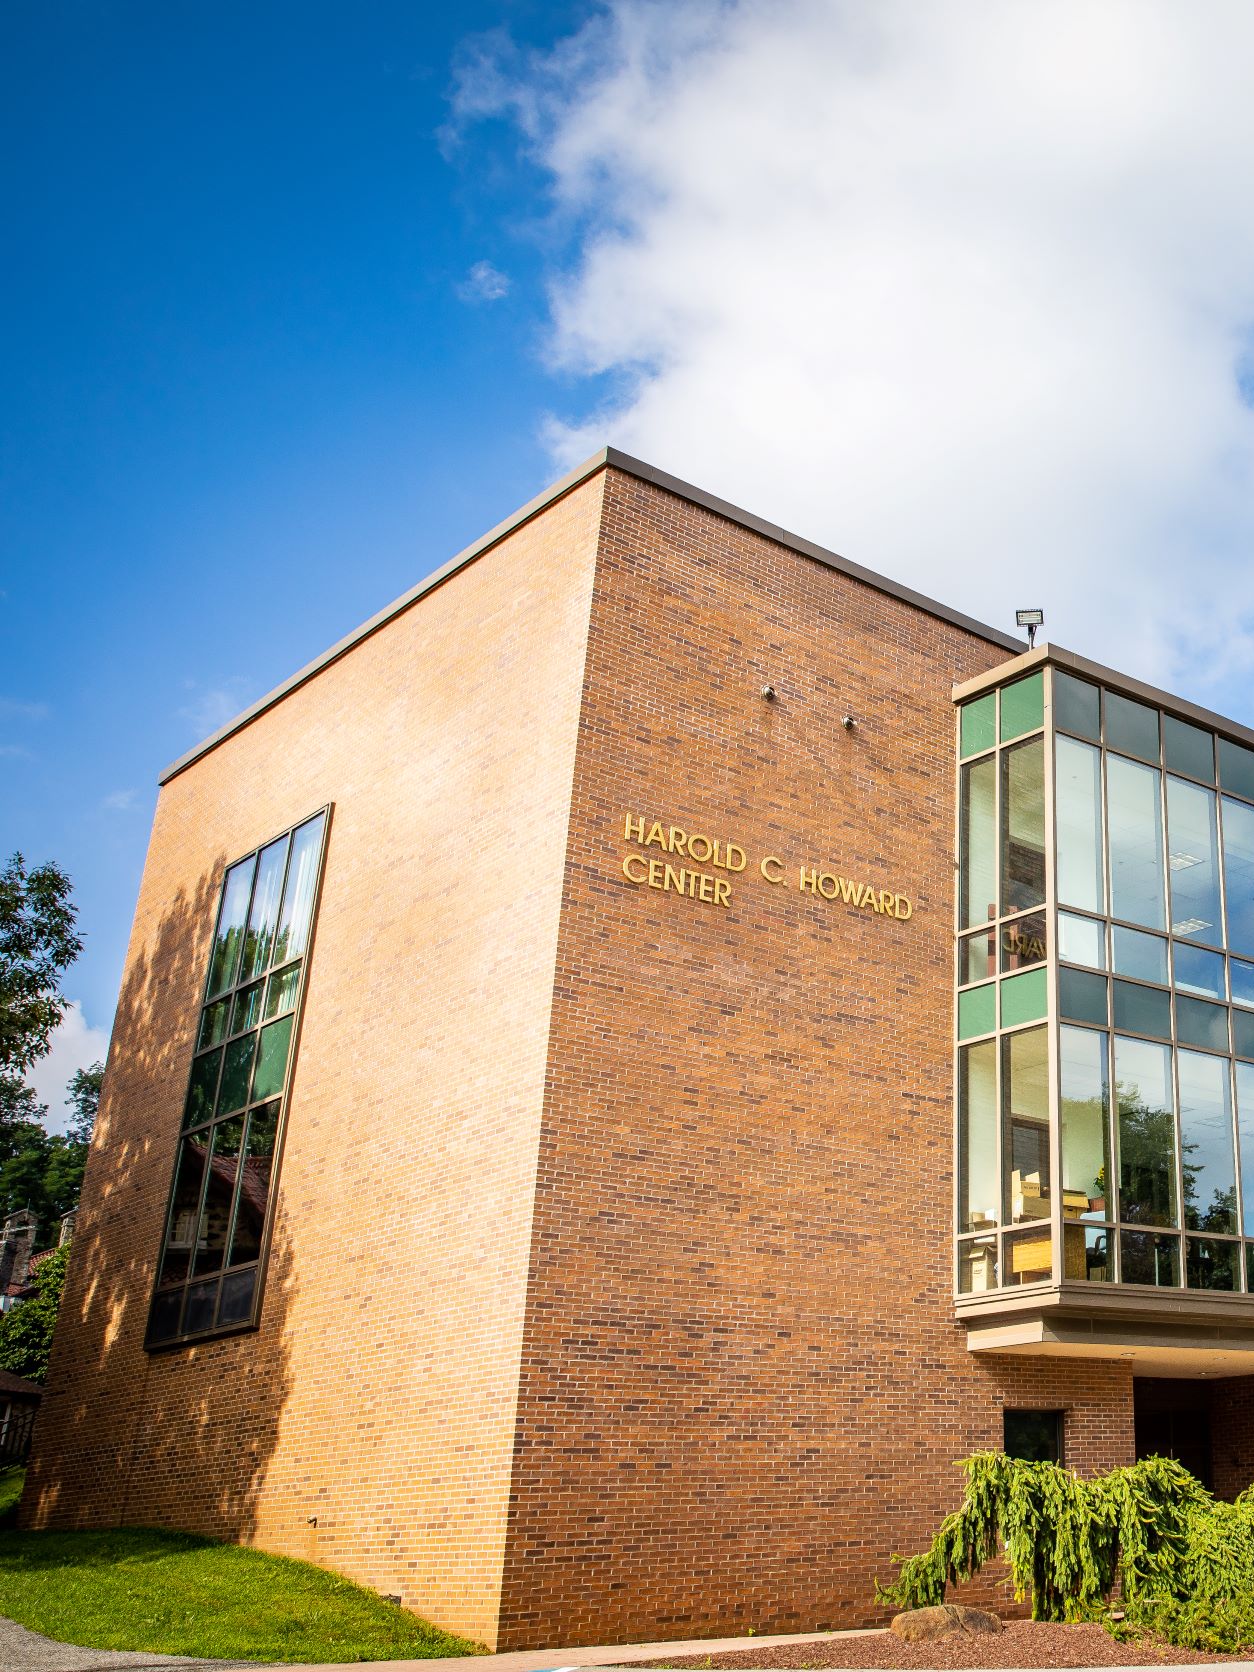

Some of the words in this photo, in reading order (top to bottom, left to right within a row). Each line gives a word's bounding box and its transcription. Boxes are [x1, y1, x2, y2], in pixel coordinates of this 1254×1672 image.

[622, 853, 732, 908] CENTER
[624, 811, 747, 873] HAROLD
[760, 855, 788, 887] C.
[799, 865, 913, 920] HOWARD
